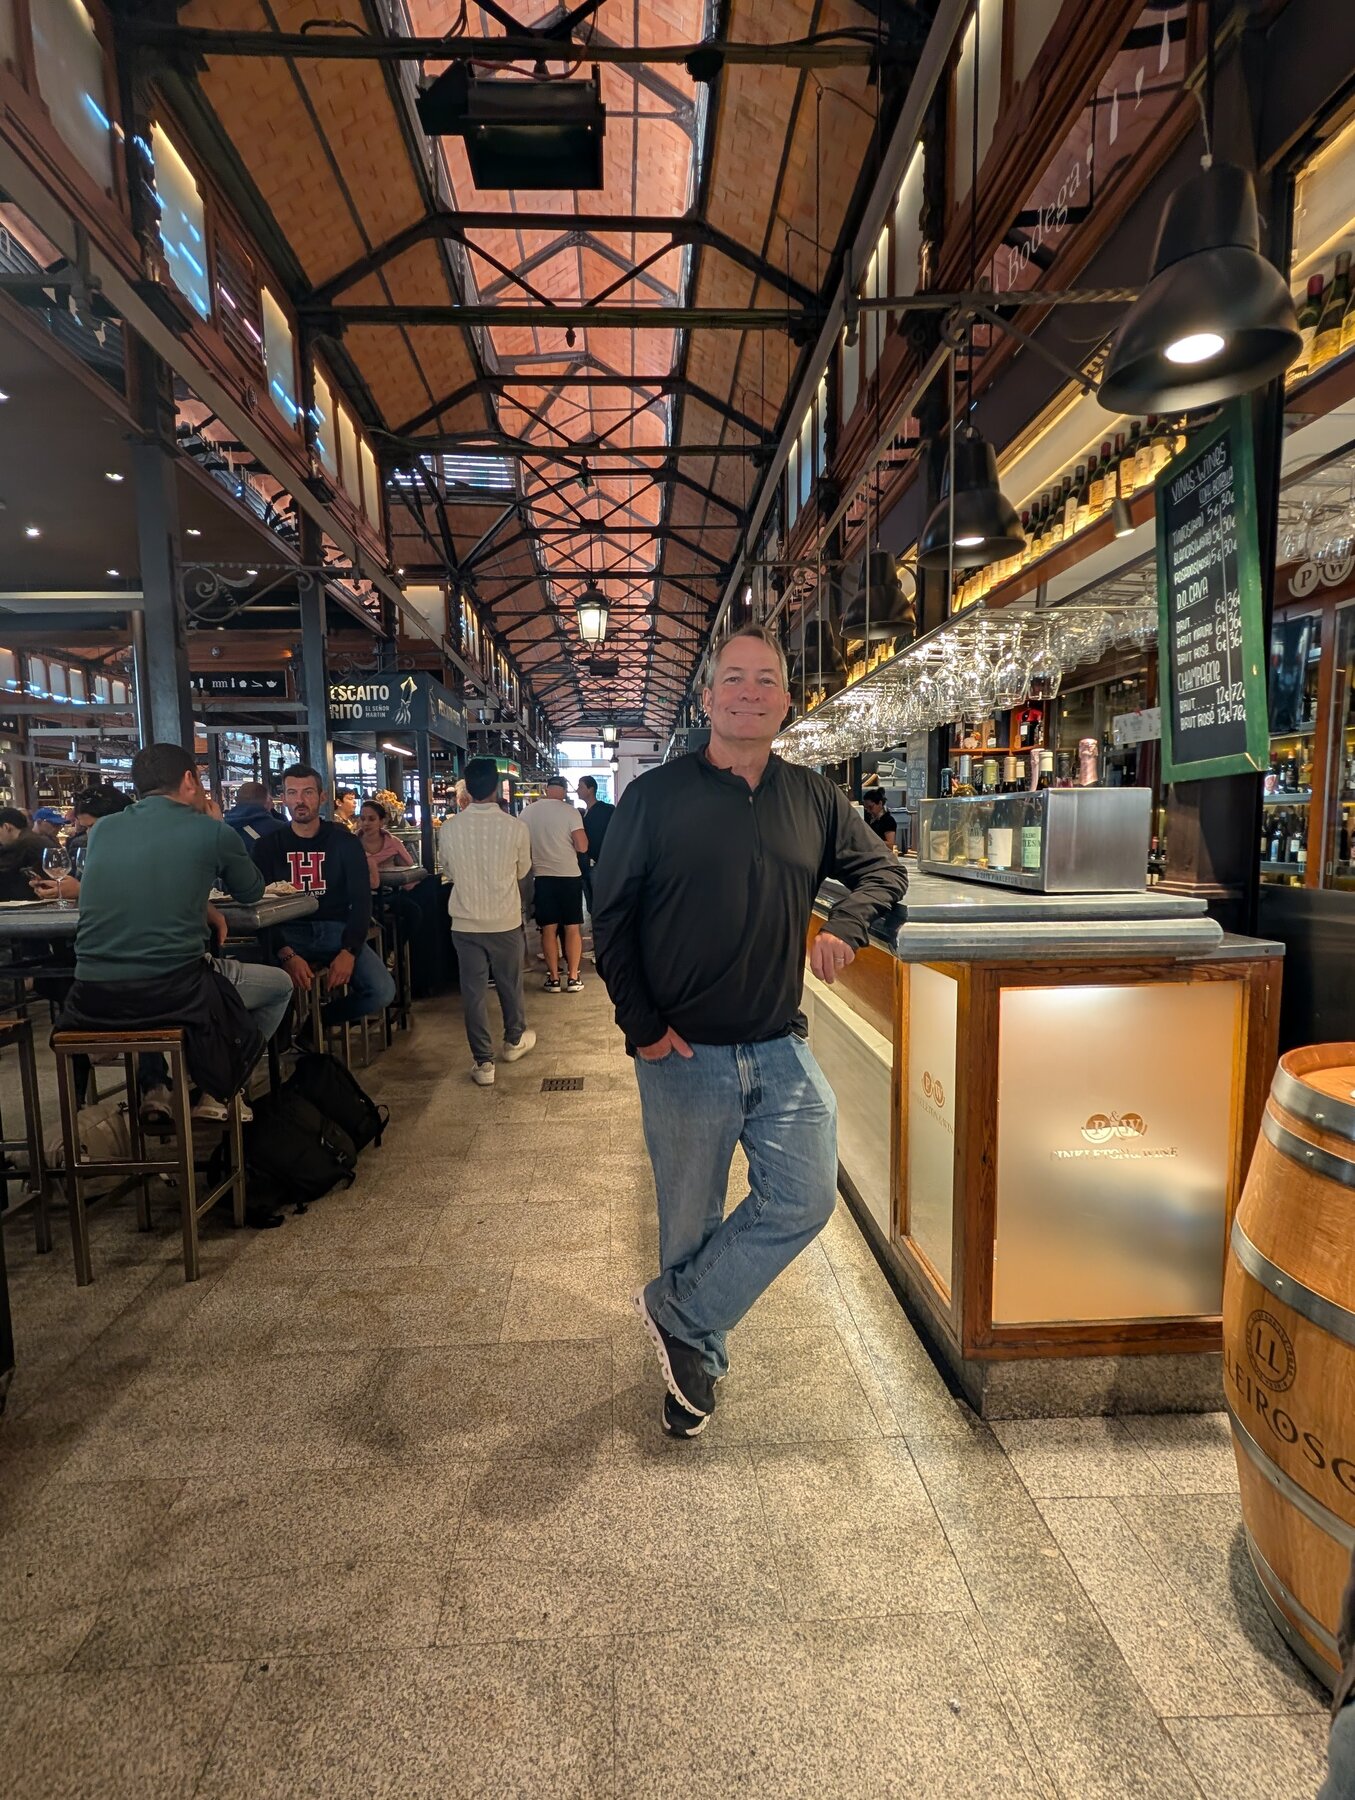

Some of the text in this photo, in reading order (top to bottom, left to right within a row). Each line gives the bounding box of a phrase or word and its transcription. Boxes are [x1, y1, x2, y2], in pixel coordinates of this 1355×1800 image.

[1007, 161, 1081, 293] Bodega
[1221, 490, 1236, 510] 30€
[1222, 515, 1237, 534] 30€
[1224, 538, 1238, 557] 30€
[1189, 576, 1209, 602] CAVA
[1216, 686, 1231, 705] 12€
[1217, 706, 1232, 724] 13€
[286, 851, 327, 892] H
